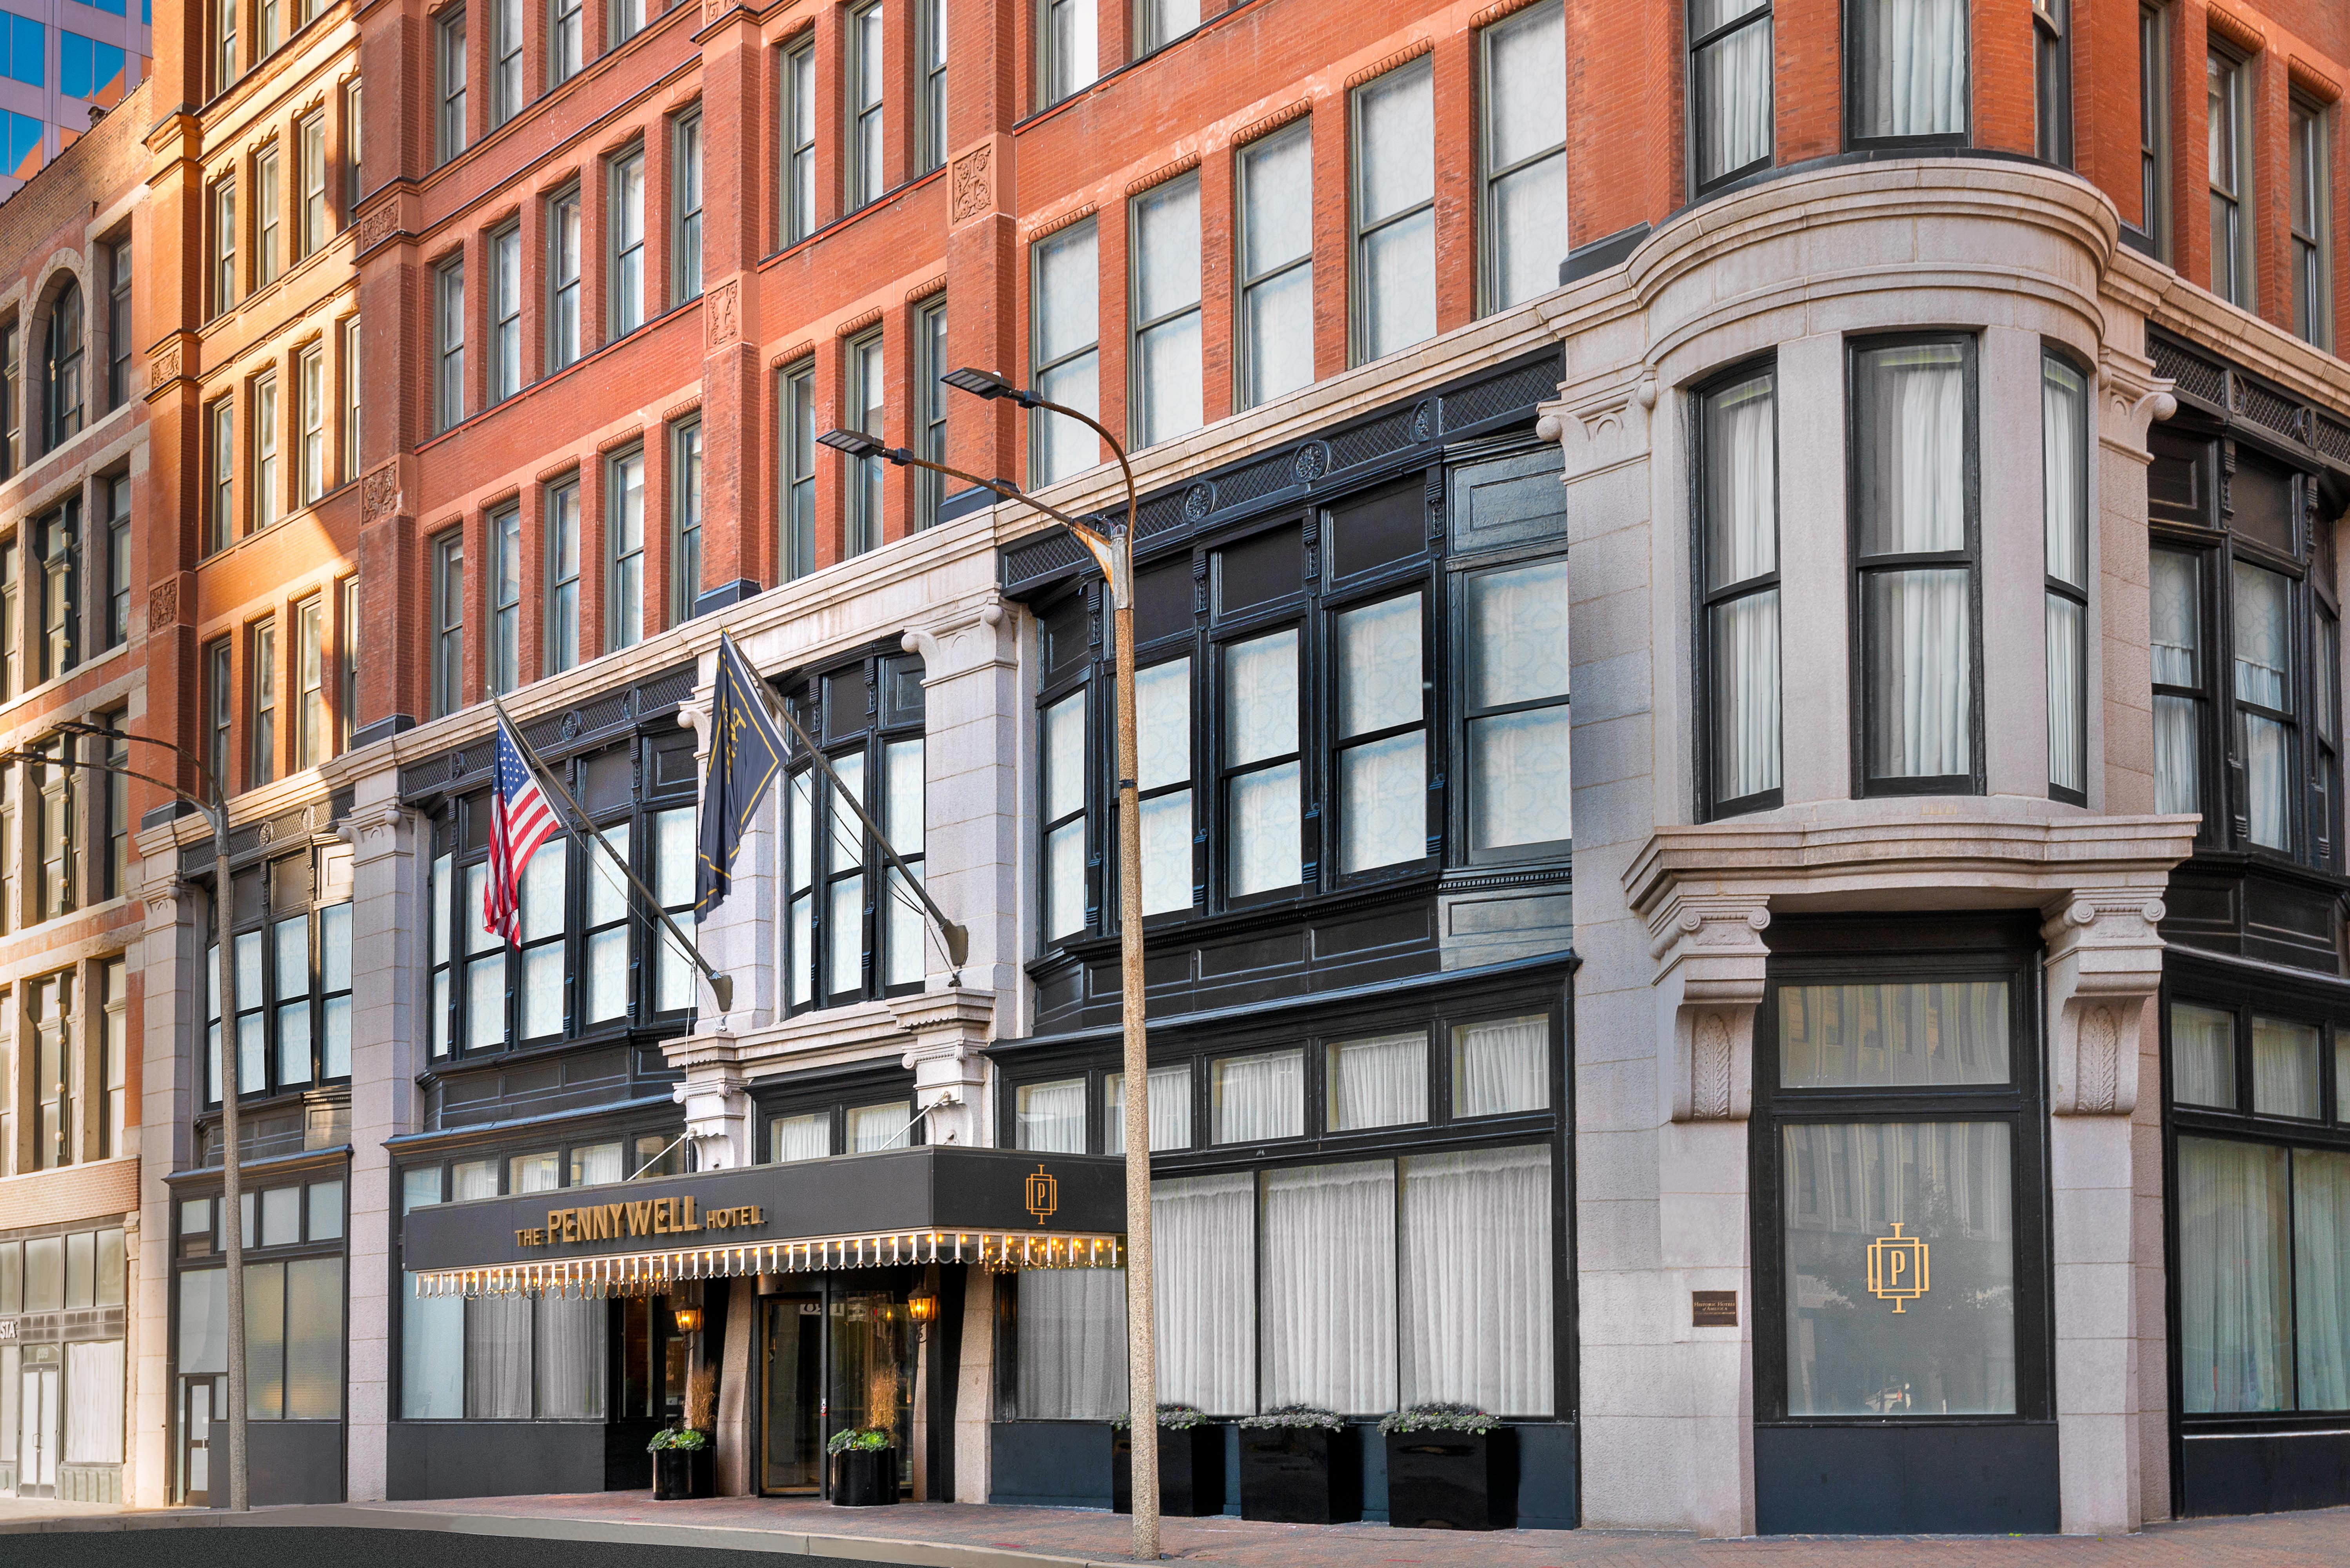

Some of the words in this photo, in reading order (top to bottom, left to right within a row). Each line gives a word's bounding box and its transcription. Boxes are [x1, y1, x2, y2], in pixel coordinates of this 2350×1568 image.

[1038, 1183, 1045, 1206] P
[514, 1227, 545, 1247] THE
[548, 1196, 703, 1244] PENNYWELL
[707, 1205, 764, 1229] HOTEL
[1891, 1250, 1905, 1285] P
[0, 1321, 16, 1339] STA
